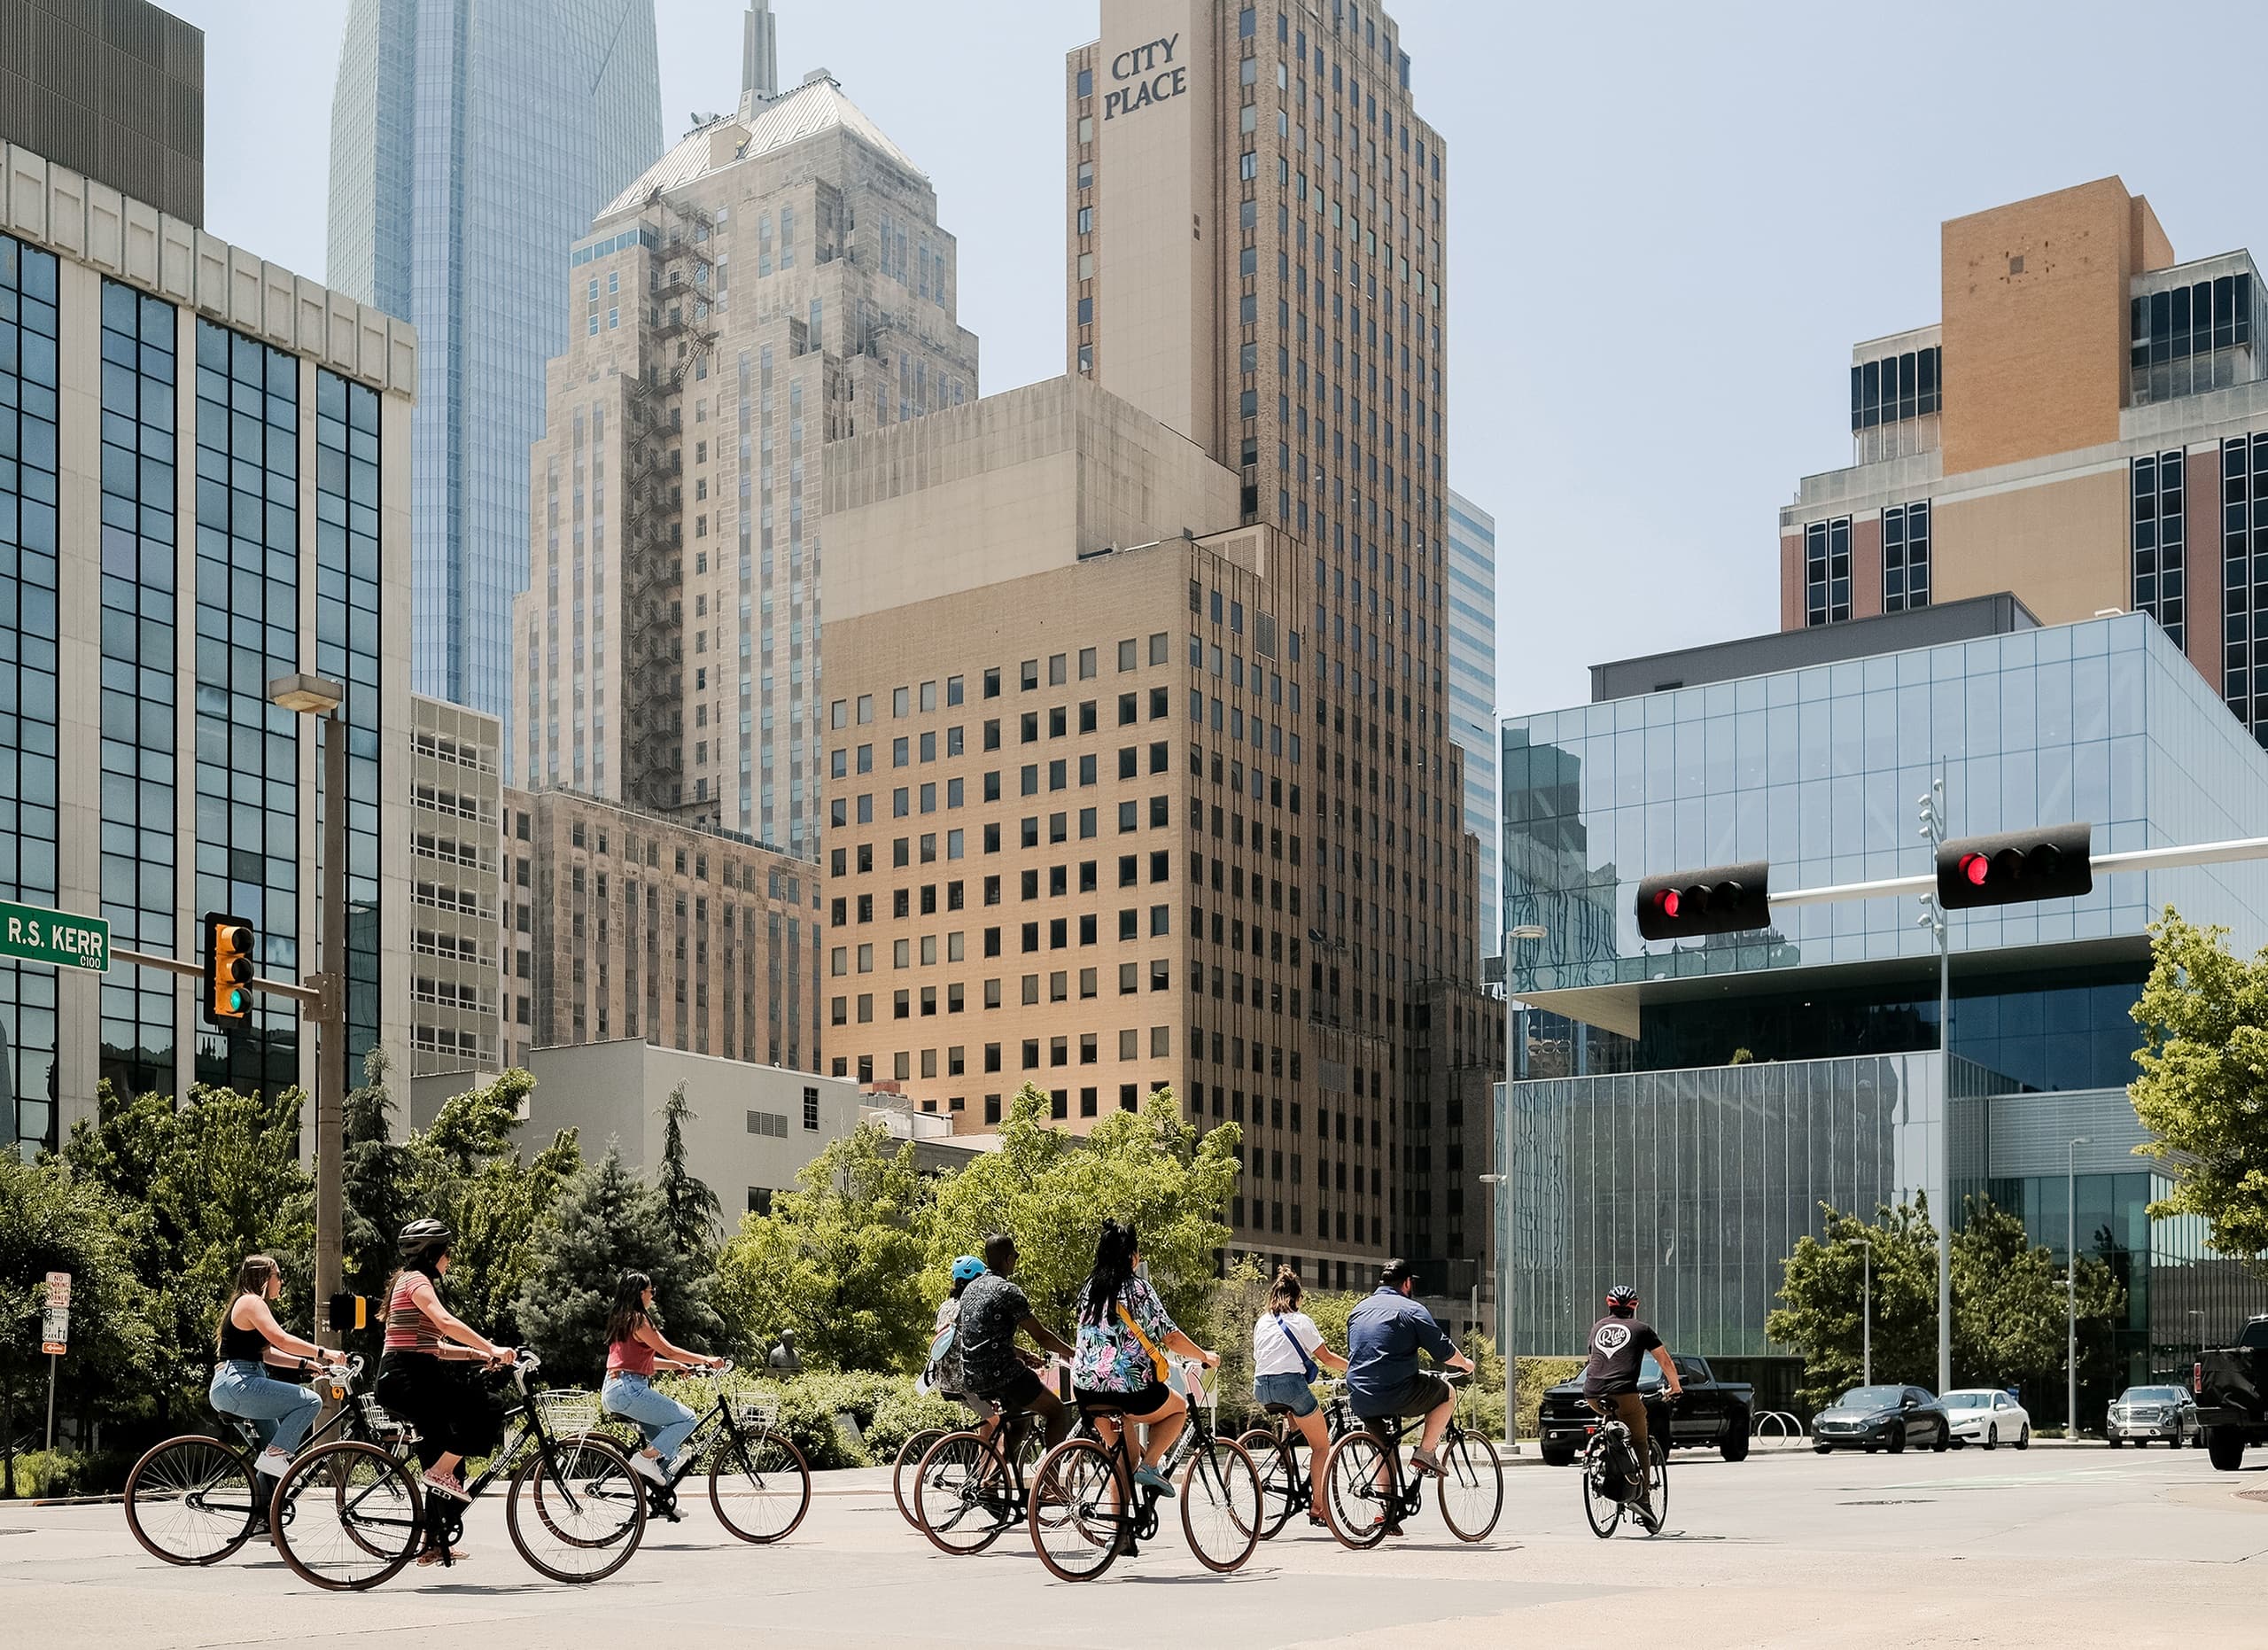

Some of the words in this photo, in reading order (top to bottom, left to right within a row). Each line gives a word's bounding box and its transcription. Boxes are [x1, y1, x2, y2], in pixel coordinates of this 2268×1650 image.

[1112, 33, 1179, 81] CITY
[1104, 66, 1187, 121] PLACE
[8, 917, 45, 947] R.S.
[51, 924, 103, 958] KERR
[80, 955, 101, 969] C100
[1598, 1328, 1625, 1346] Ride
